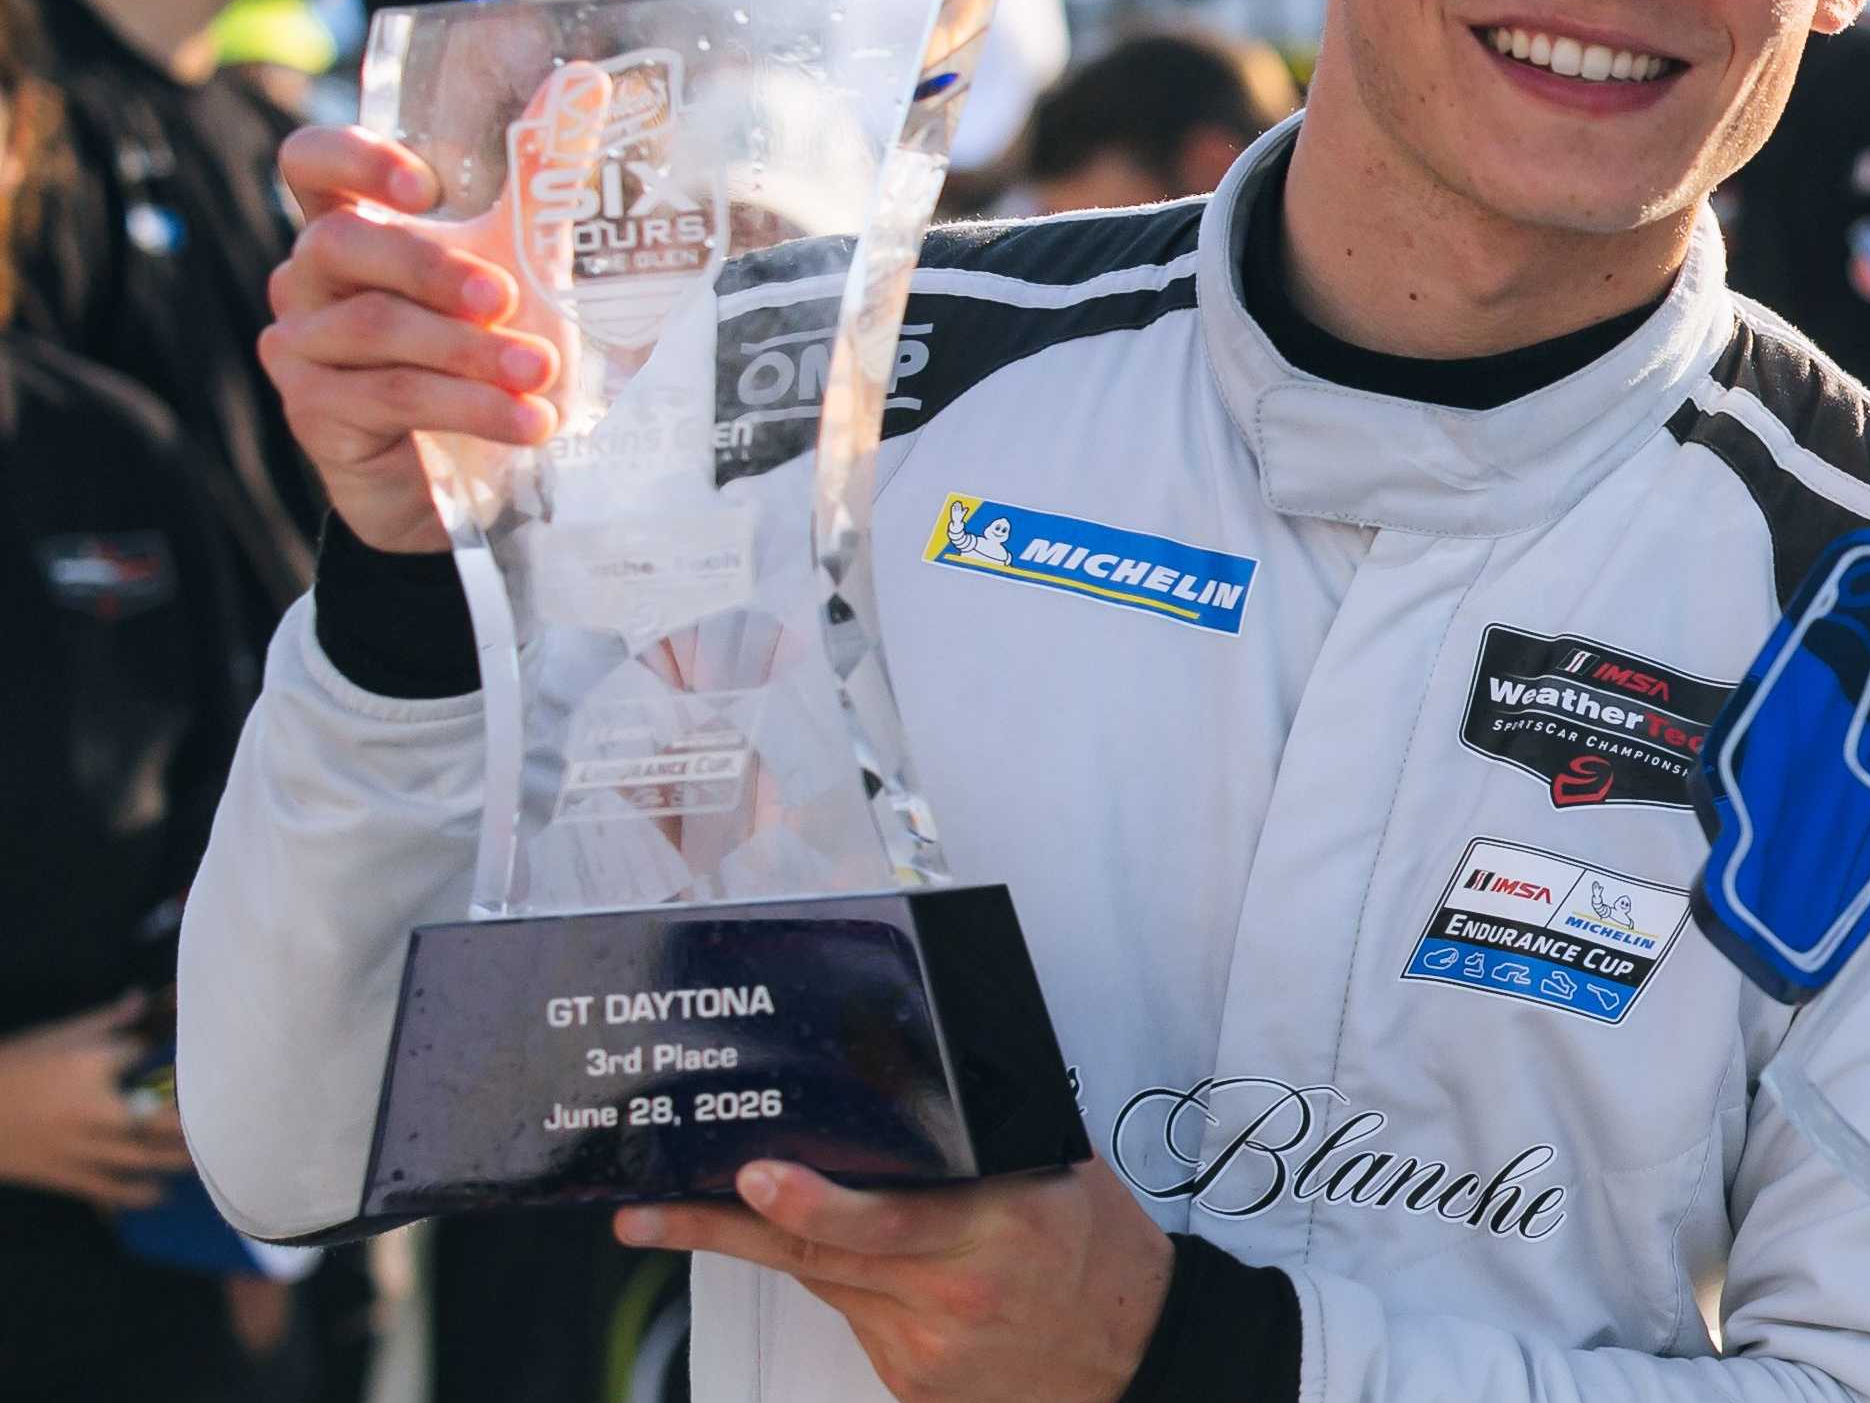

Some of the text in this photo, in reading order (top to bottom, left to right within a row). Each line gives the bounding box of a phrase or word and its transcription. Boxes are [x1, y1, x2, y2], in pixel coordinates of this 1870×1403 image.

[530, 159, 703, 222] SIX
[533, 214, 706, 255] HOURS
[1019, 538, 1244, 610] MICHELIN
[1593, 662, 1671, 702] IMSA
[1489, 676, 1704, 754] WeatherTec
[1490, 875, 1554, 905] IMSA
[1444, 912, 1636, 980] ENDURANCE CUP
[1564, 914, 1657, 951] MICHELIN
[546, 984, 776, 1028] GT DAYTONA
[585, 1043, 738, 1077] 3rd Place
[543, 1089, 783, 1131] June 28, 2026
[1112, 1076, 1566, 1242] Blanche
